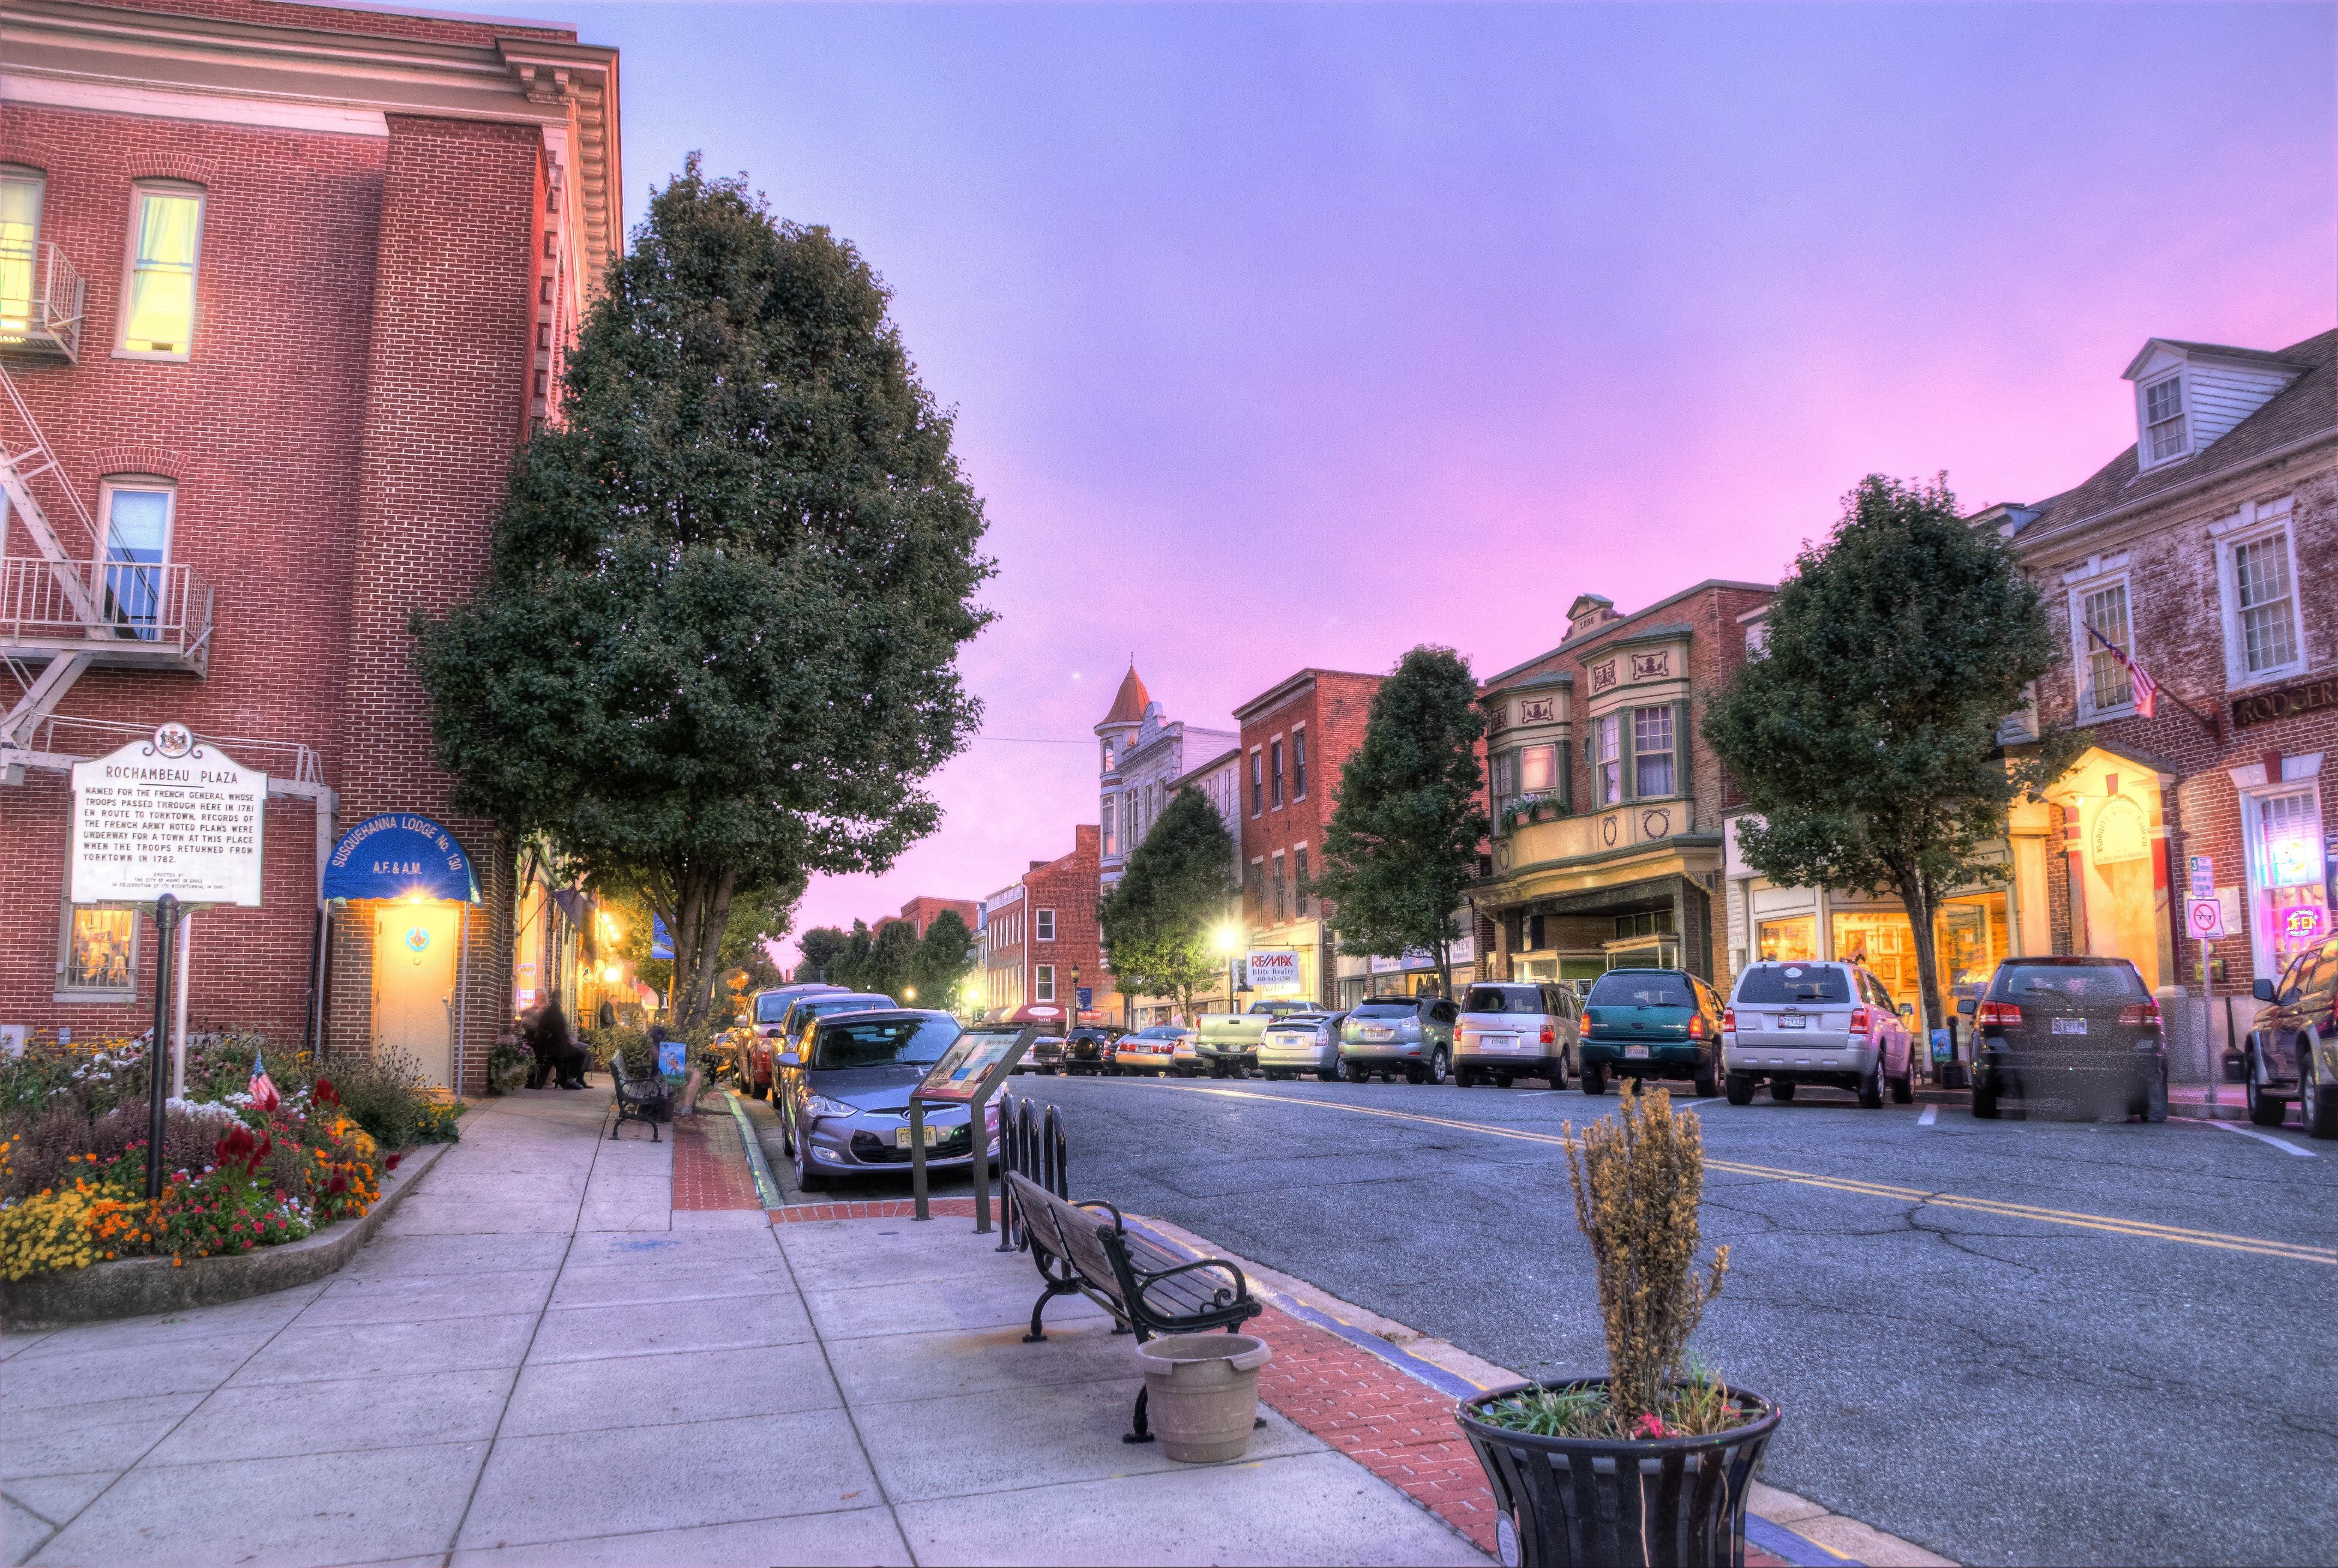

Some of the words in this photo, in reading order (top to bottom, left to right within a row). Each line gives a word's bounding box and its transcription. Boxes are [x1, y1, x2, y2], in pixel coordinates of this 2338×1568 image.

[106, 766, 190, 781] ROCHAMBEAU
[200, 771, 238, 784] PLAZA
[85, 787, 113, 795] NAMED
[189, 792, 225, 800] GENERAL
[121, 799, 152, 808] PASSED
[157, 801, 196, 810] THROUGH
[202, 814, 239, 822] RECORDS
[83, 831, 128, 840] UNDERWAY
[178, 845, 224, 853] RETURNED
[331, 816, 397, 868] SUSQUEHANNA
[402, 816, 438, 839] LODGE
[447, 853, 462, 870] 130
[393, 862, 400, 874] &
[1252, 955, 1293, 967] RE/MAX
